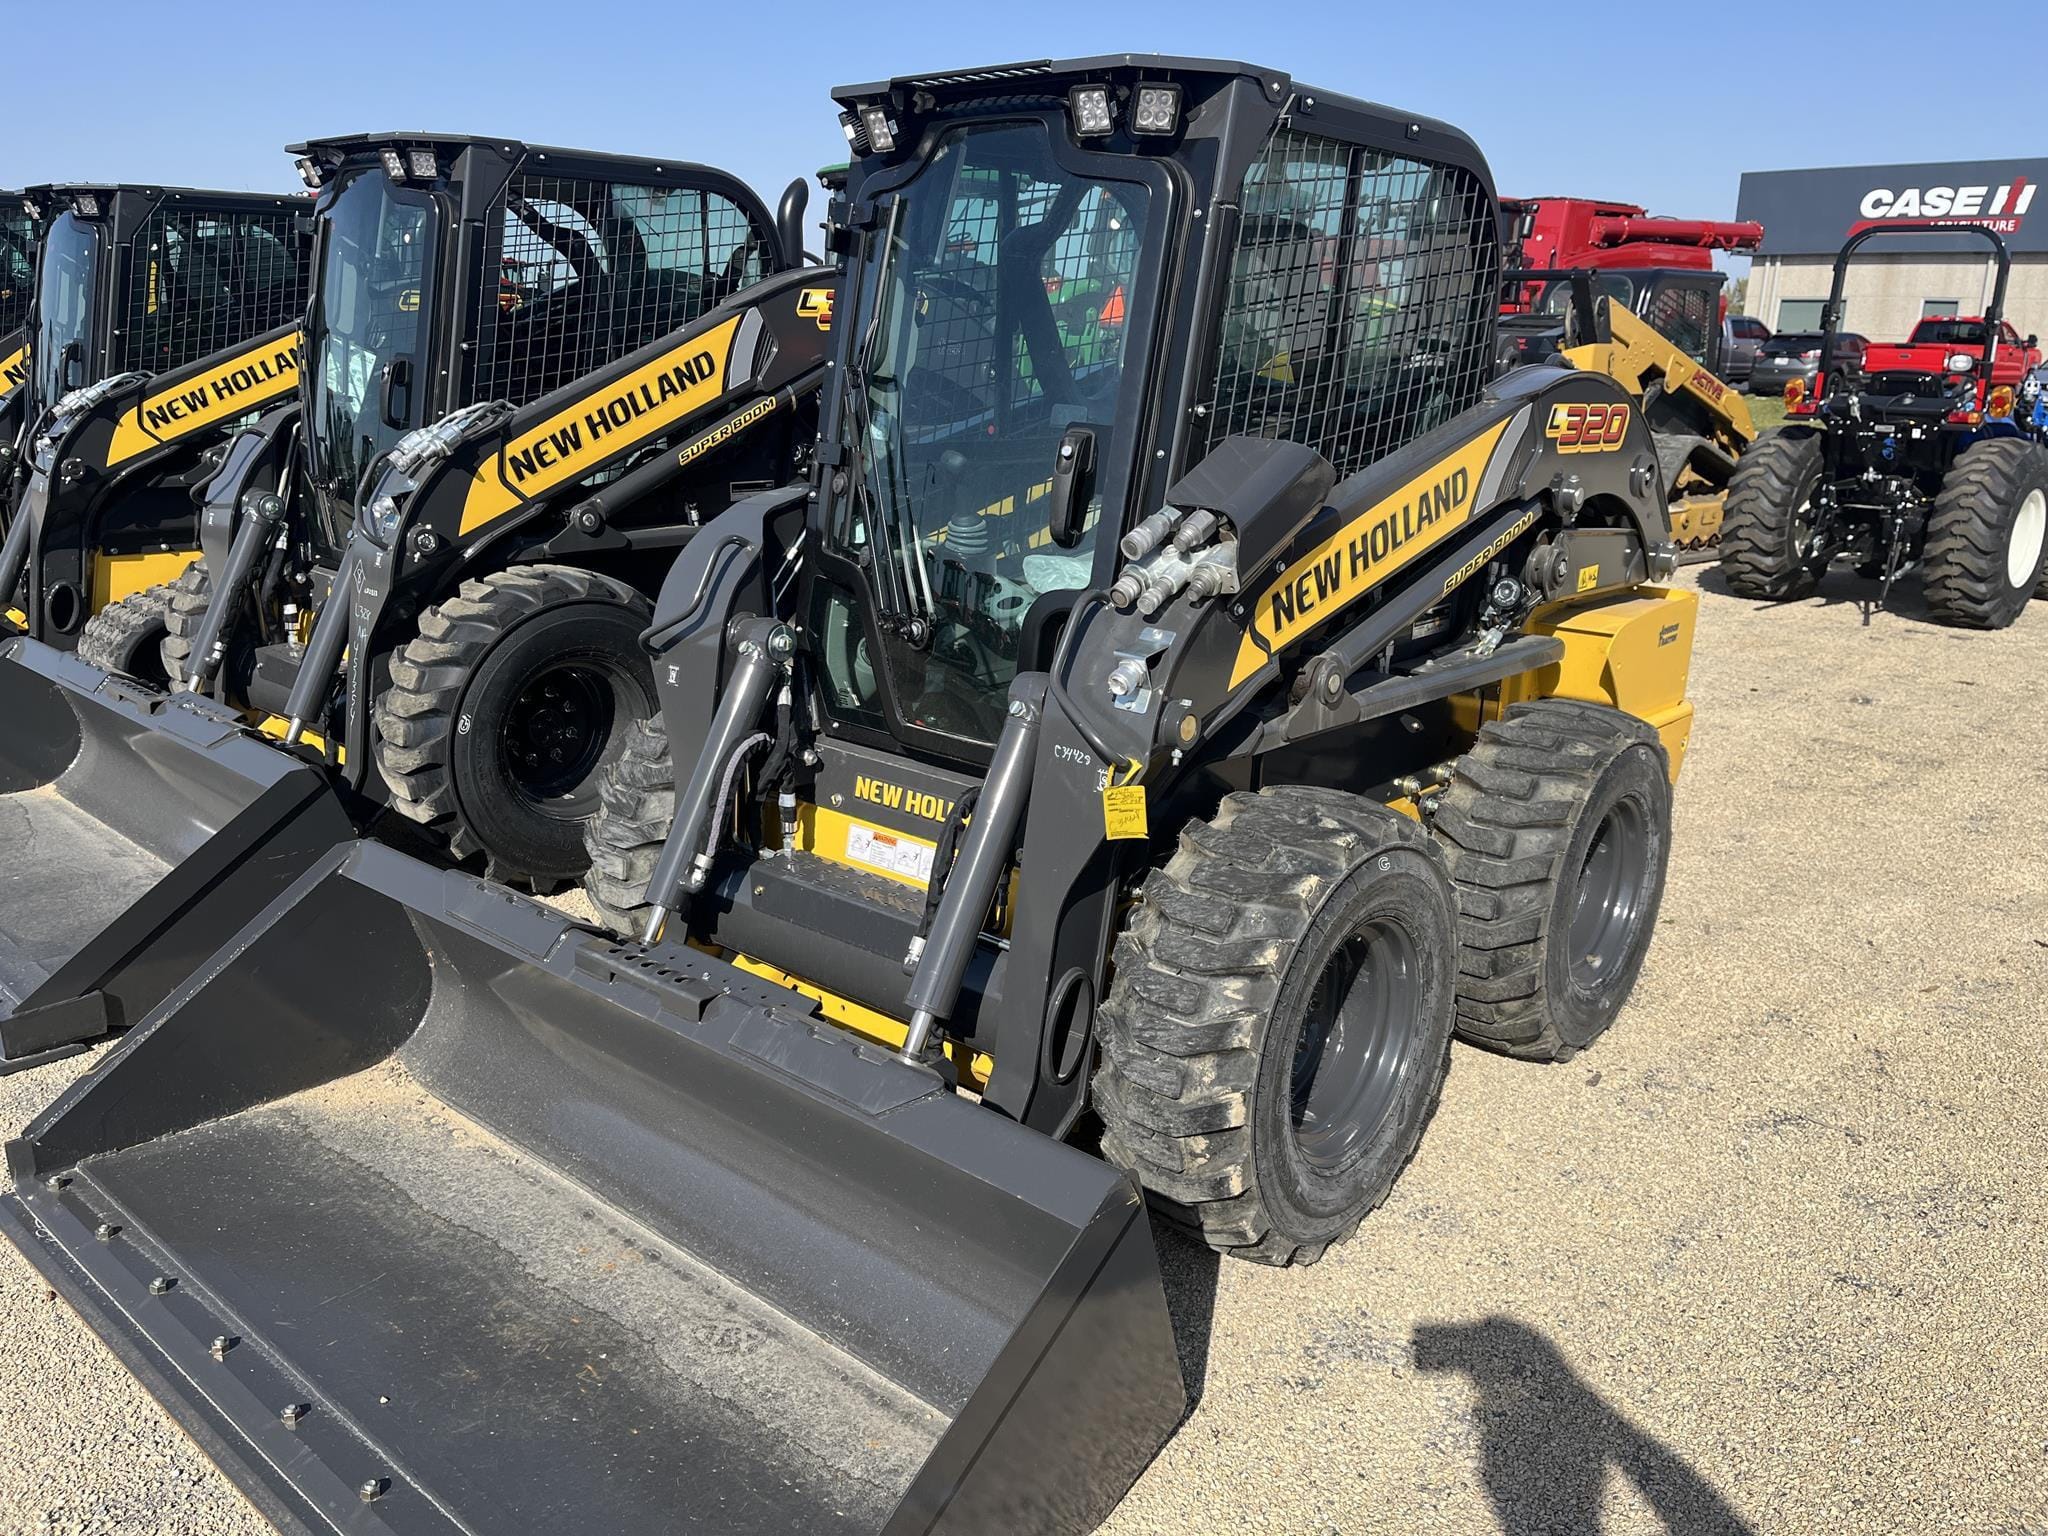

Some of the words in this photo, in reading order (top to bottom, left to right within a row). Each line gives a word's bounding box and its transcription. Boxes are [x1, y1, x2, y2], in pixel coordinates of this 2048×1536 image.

[1860, 186, 1989, 218] CASE
[145, 386, 210, 430] NEW
[508, 421, 582, 482] NEW
[584, 351, 716, 440] HOLLAND
[678, 424, 732, 465] SUPER
[731, 395, 777, 434] BOOM
[1546, 403, 1631, 454] L320
[1271, 550, 1342, 634] NEW
[1348, 466, 1469, 582] HOLLAND
[1443, 545, 1494, 598] SUPER
[1493, 511, 1534, 556] BOOM
[854, 775, 904, 810] NEW
[1378, 856, 1391, 871] G
